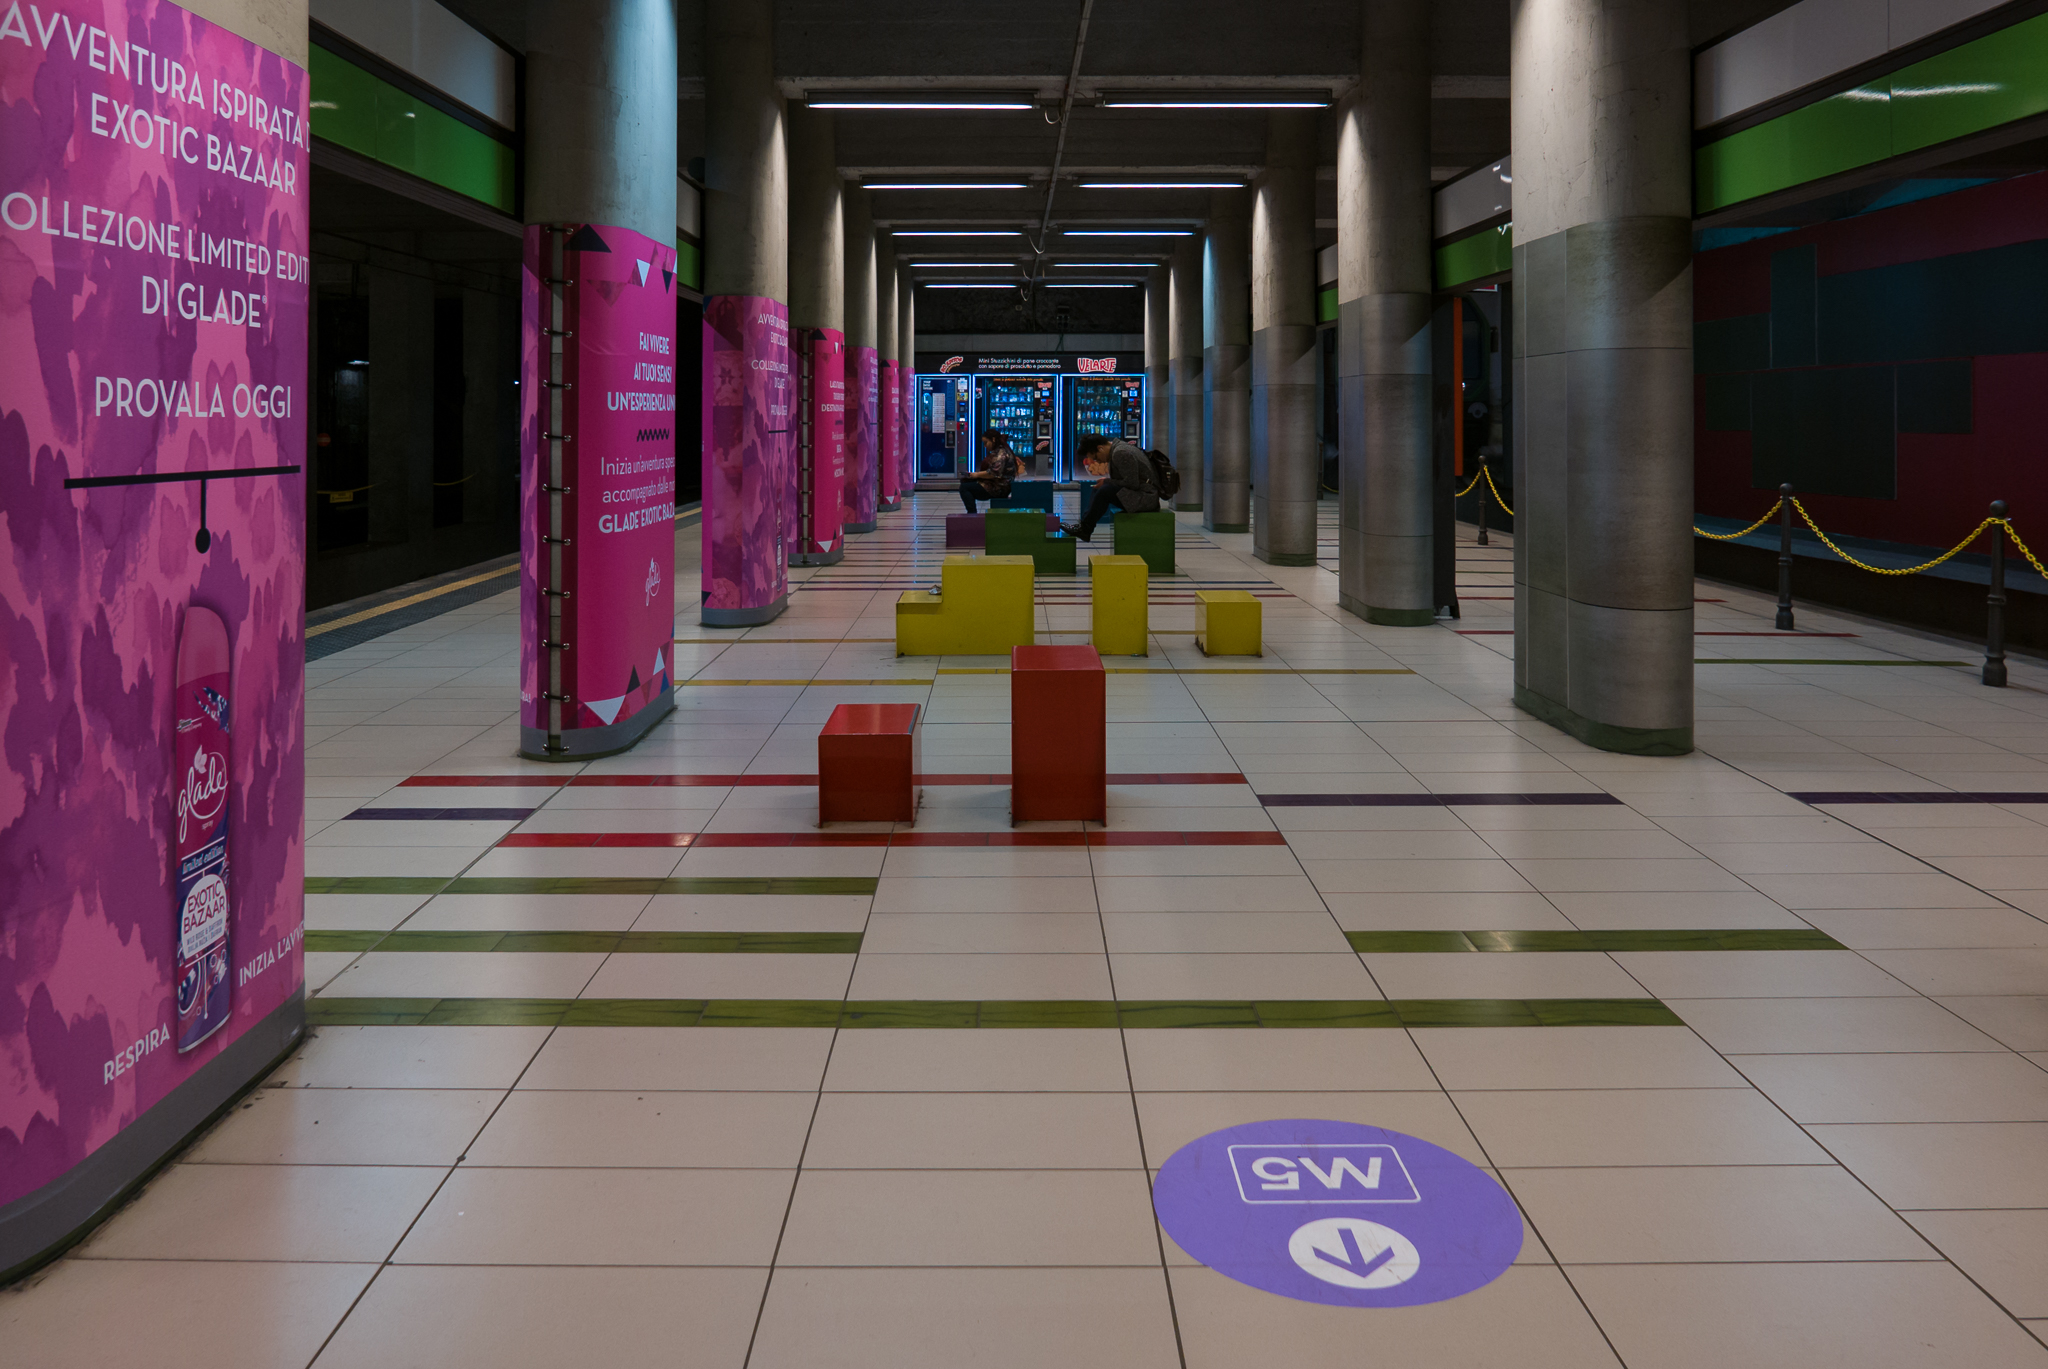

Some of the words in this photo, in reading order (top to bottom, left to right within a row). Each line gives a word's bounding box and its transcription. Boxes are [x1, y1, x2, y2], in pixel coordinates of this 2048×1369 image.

[0, 0, 205, 111] AVVENTURA
[213, 77, 304, 149] ISPIRATA
[91, 92, 199, 165] EXOTIC
[207, 132, 296, 196] BAZAAR
[1, 192, 181, 259] OLLEZIONE
[188, 228, 271, 276] LIMITED
[142, 275, 168, 317] DI
[639, 331, 649, 352] FAI
[633, 362, 641, 380] AI
[641, 362, 657, 382] TUOI
[657, 364, 672, 383] SENSI
[1037, 362, 1061, 370] pomodoro
[1077, 358, 1117, 373] VELARTE
[95, 376, 226, 418] PROVALA
[232, 382, 292, 418] OGGI
[607, 391, 667, 411] UN'ESPERIENZA
[601, 456, 632, 475] Inizia
[602, 480, 657, 504] accompagnato
[641, 504, 663, 527] EXOTIC
[178, 752, 229, 844] glade
[187, 880, 222, 914] EXOTIC
[184, 896, 226, 935] BAZAAR
[239, 947, 276, 988] INIZIA
[103, 1022, 171, 1086] RESPIRA
[1251, 1156, 1383, 1191] M5
